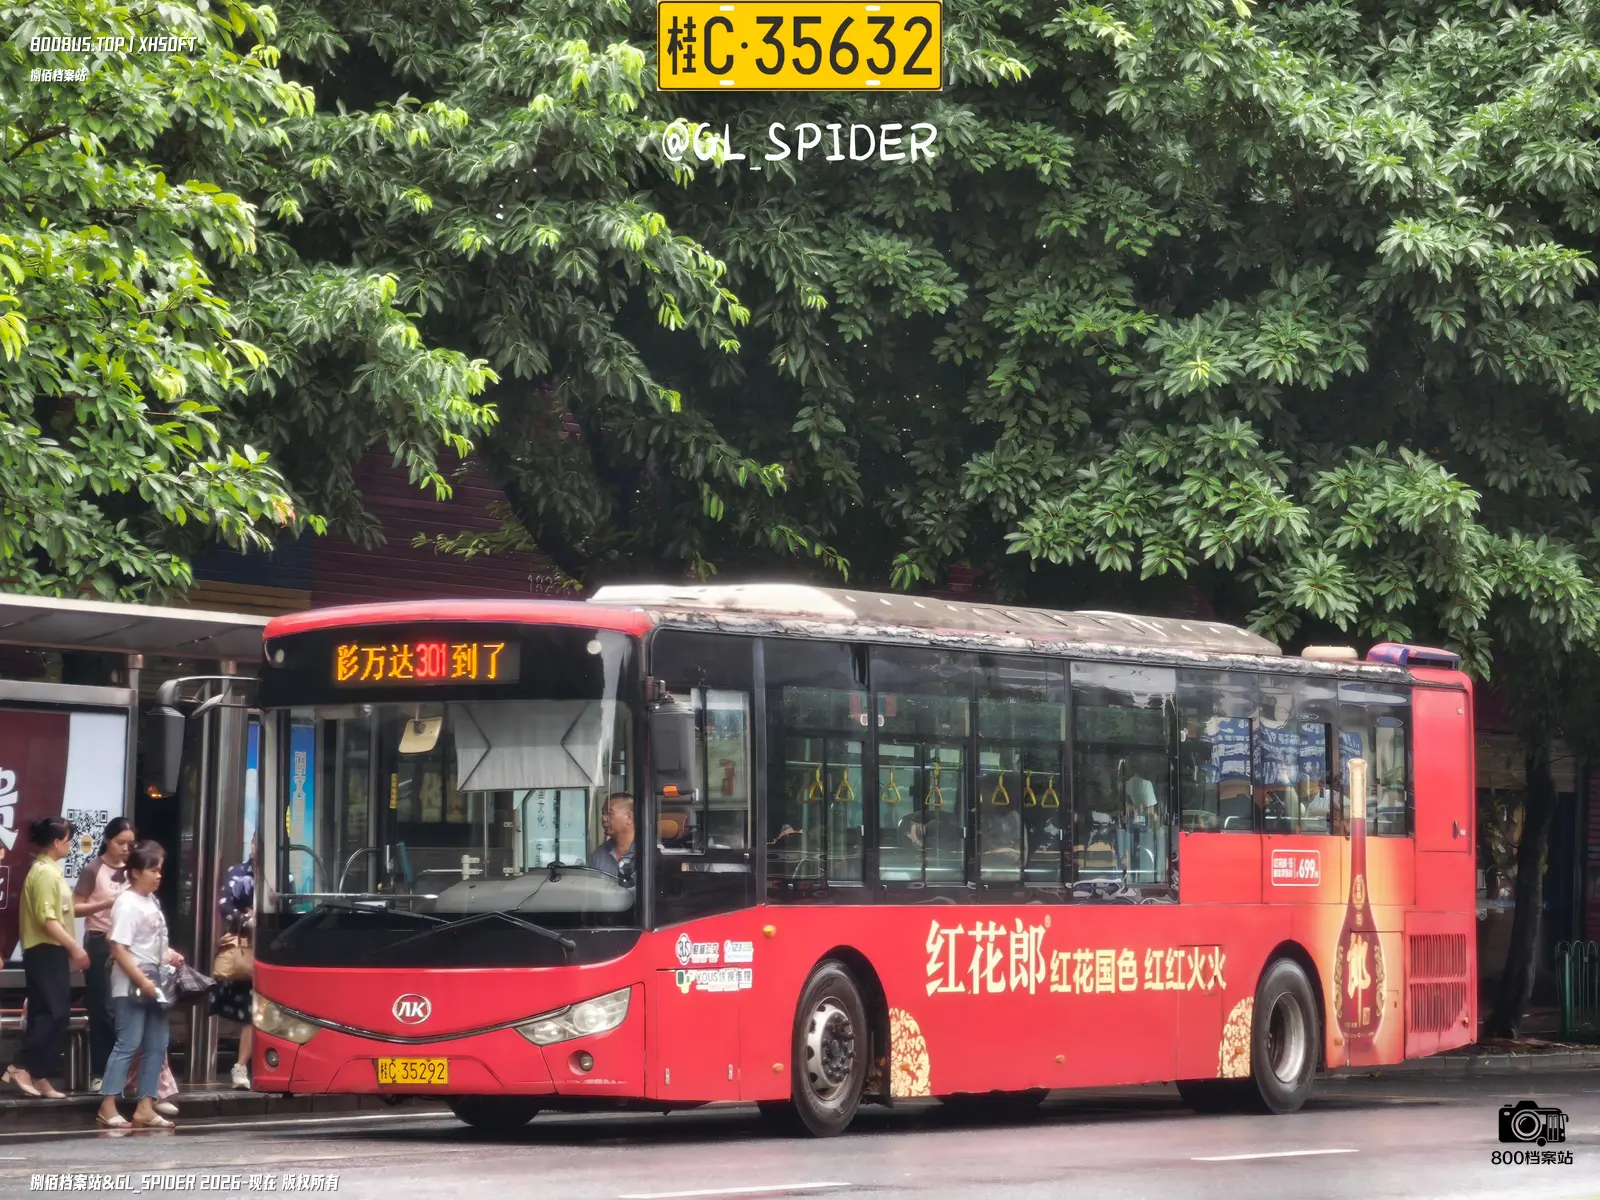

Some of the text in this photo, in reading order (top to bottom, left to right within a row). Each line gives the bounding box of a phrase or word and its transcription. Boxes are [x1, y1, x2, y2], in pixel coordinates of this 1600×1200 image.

[925, 917, 1046, 998] 红花郎
[1050, 946, 1227, 994] 红花国色 红红火火
